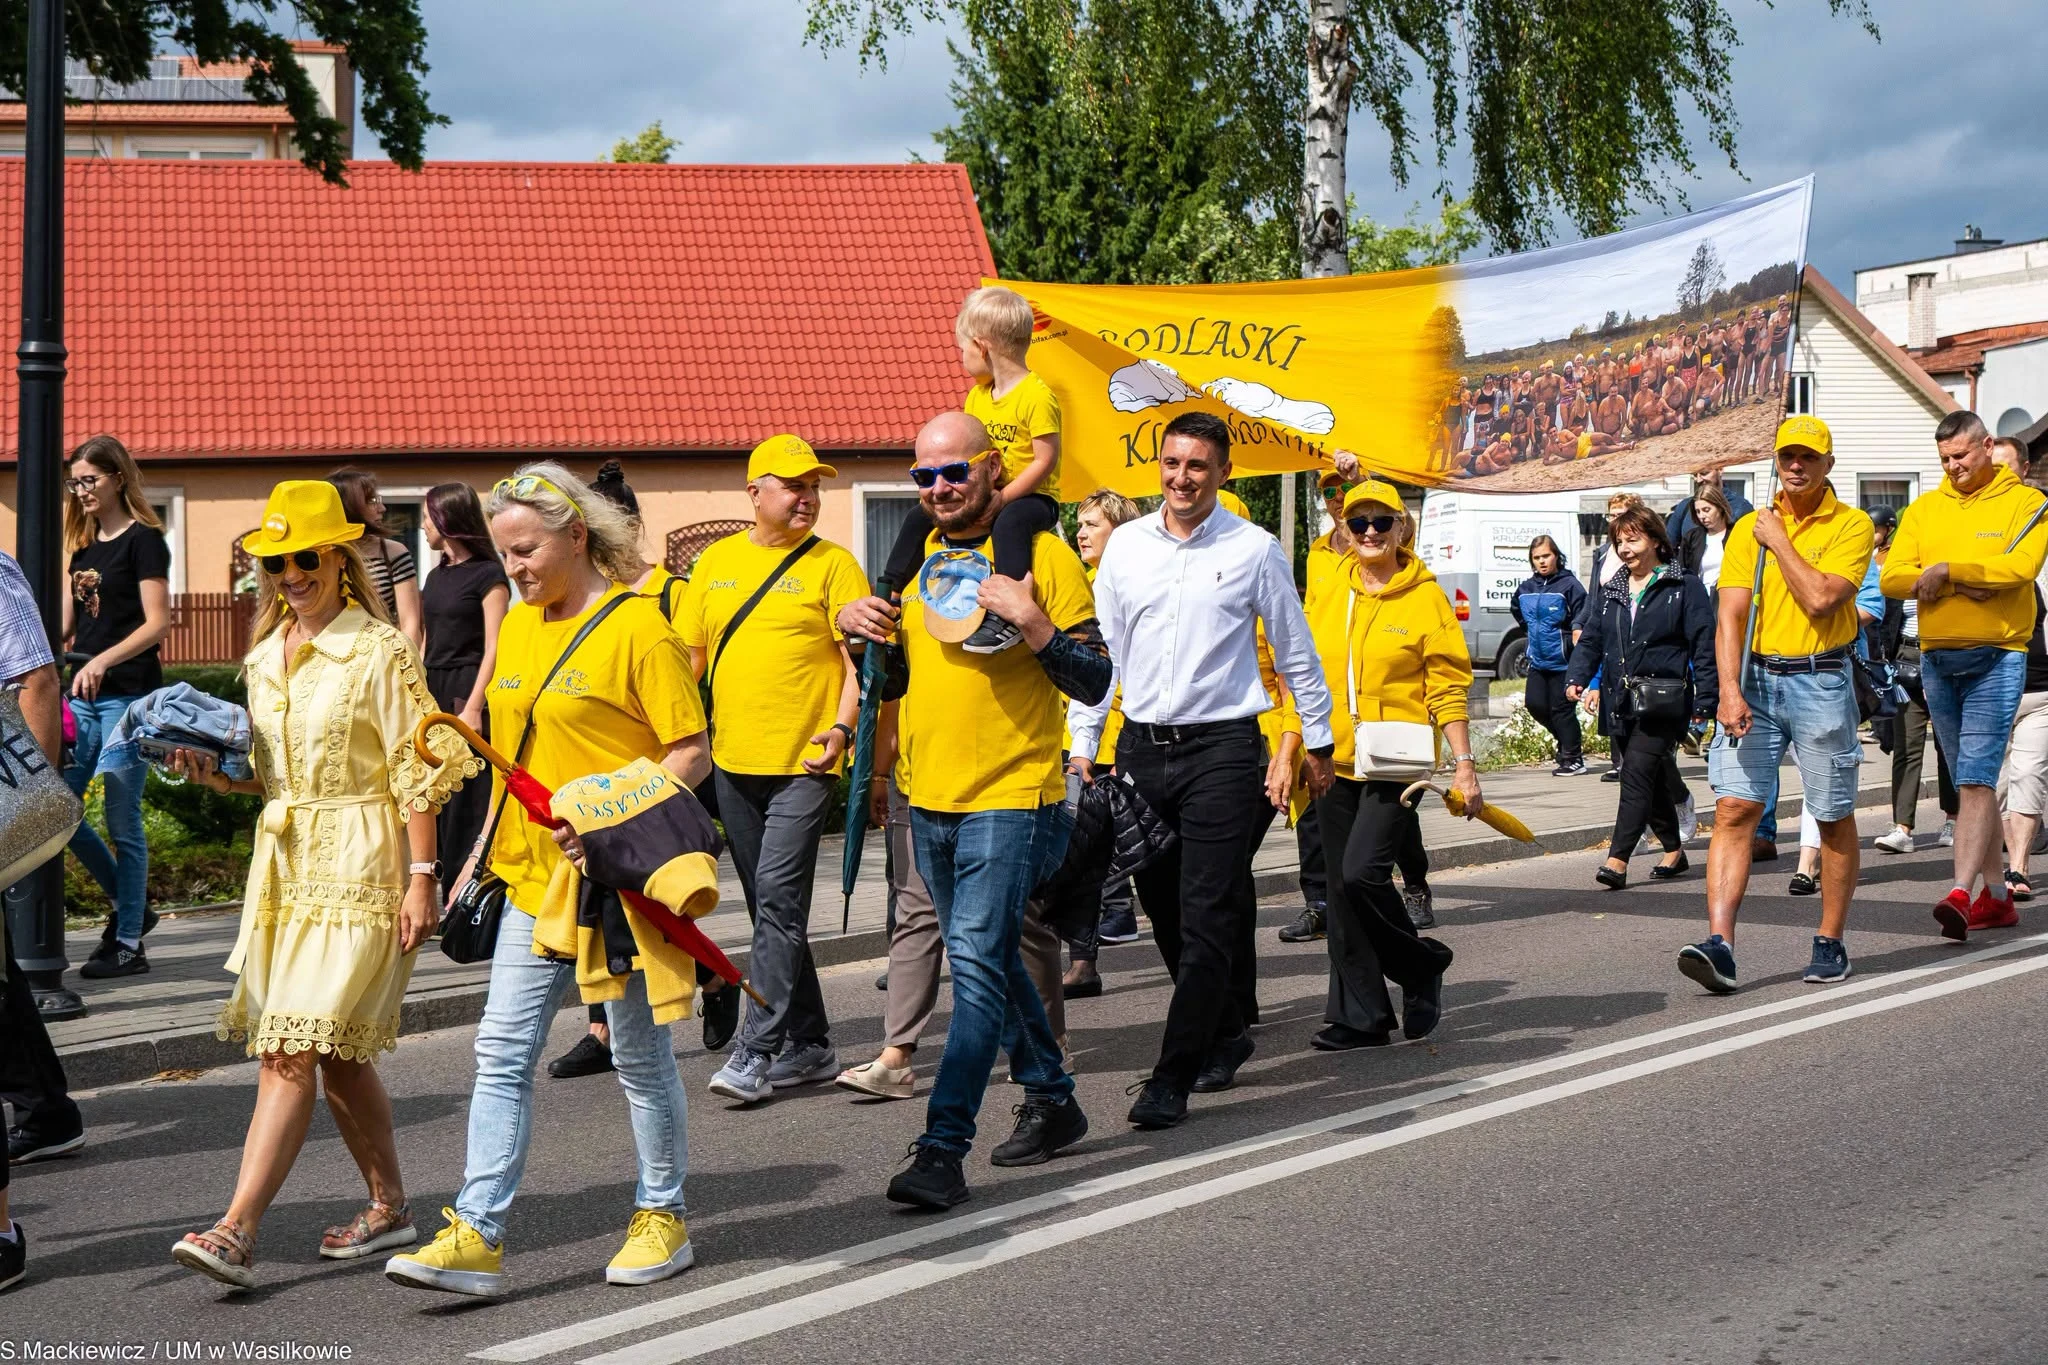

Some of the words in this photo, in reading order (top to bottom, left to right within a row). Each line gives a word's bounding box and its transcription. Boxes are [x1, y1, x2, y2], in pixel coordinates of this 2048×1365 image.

[1492, 526, 1552, 535] STOLARNIA
[1492, 535, 1533, 543] KRUSZ
[1496, 577, 1521, 588] soli
[1486, 589, 1513, 600] term
[576, 775, 665, 818] ODLASKI
